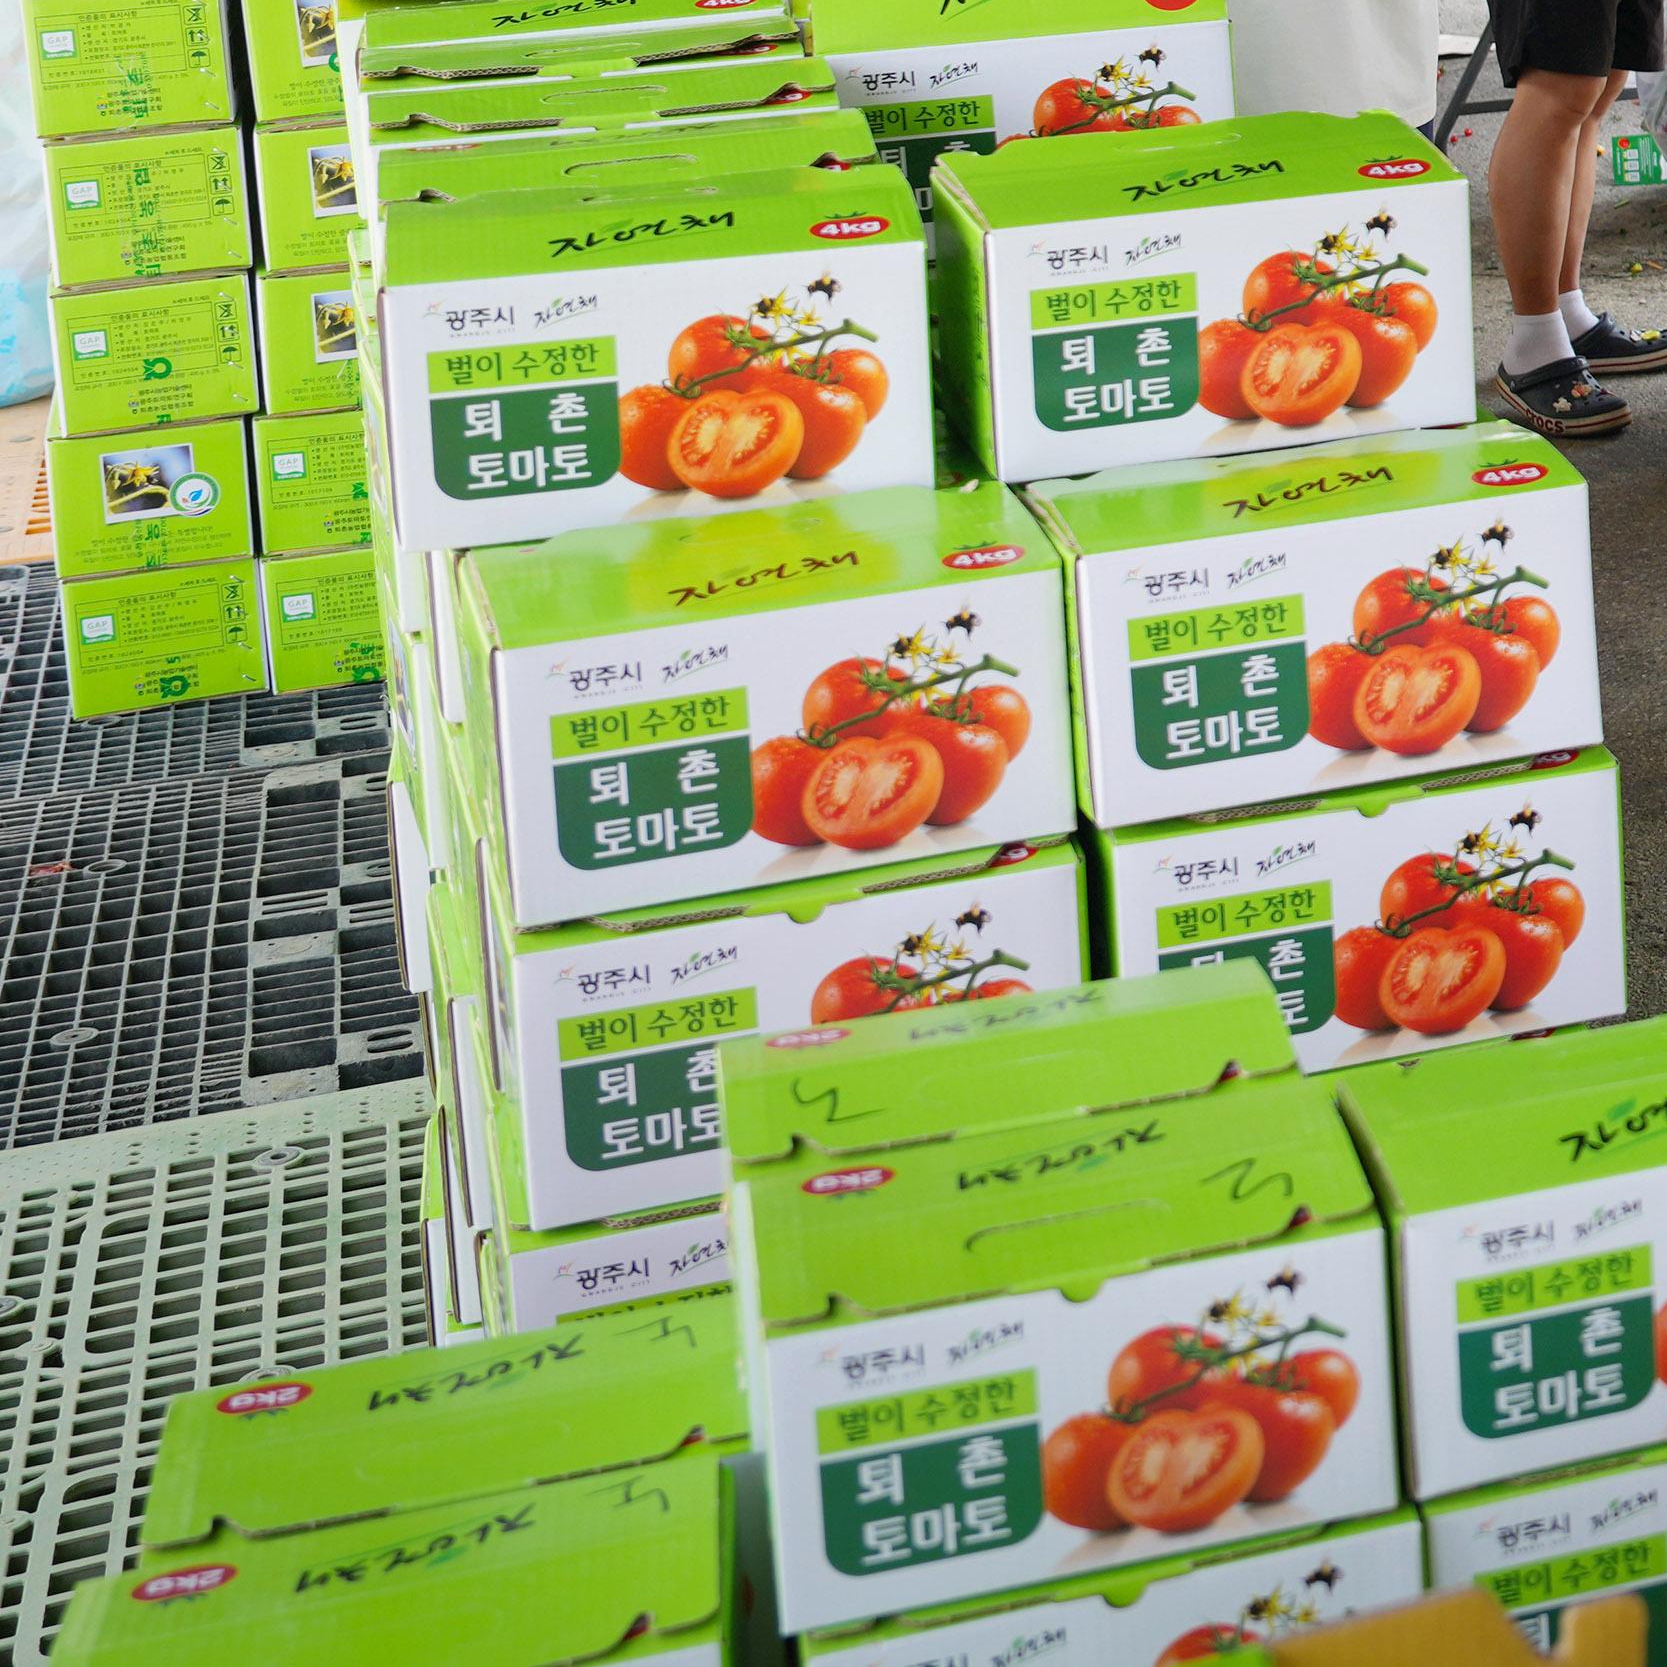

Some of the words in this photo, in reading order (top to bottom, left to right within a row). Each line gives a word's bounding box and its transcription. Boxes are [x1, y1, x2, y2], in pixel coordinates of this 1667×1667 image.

[864, 71, 916, 92] 광주시
[915, 101, 979, 129] 수정한
[1122, 158, 1285, 202] 자연채
[1366, 160, 1425, 176] 4kg
[550, 211, 735, 258] 자연채
[818, 220, 881, 237] 4kg
[1047, 246, 1108, 271] 광주시
[1125, 235, 1181, 265] 자연채
[446, 306, 515, 332] 광주시
[534, 296, 597, 327] 자연채
[1047, 290, 1095, 322] 벌이
[1106, 280, 1181, 314] 수정한
[446, 353, 501, 385] 벌이
[513, 344, 598, 378] 수정한
[1065, 377, 1174, 422] 토마토
[468, 444, 592, 490] 토마토
[1480, 466, 1541, 483] 4kg
[1222, 465, 1394, 518] 자연채
[668, 551, 860, 607] 자연채
[951, 548, 1017, 568] 4kg
[1144, 568, 1209, 597] 광주시
[1227, 554, 1286, 588] 자연채
[1145, 616, 1197, 652] 벌이
[1208, 603, 1287, 642] 수정한
[570, 662, 642, 692] 광주시
[662, 646, 728, 682] 자연채
[570, 712, 628, 749] 벌이
[641, 696, 729, 737] 수정한
[1167, 707, 1283, 759] 토마토
[594, 803, 724, 859] 토마토
[1174, 857, 1238, 886] 광주시
[1257, 842, 1315, 876] 자연채
[1174, 904, 1225, 939] 벌이
[1236, 889, 1315, 928] 수정한
[578, 964, 650, 995] 광주시
[578, 1014, 636, 1051] 벌이
[649, 997, 737, 1038] 수정한
[602, 1102, 722, 1159] 토마토
[811, 1168, 886, 1189] 2kg
[1472, 1222, 1547, 1258] 광주시
[577, 1258, 649, 1291] 광주시
[1471, 1275, 1532, 1317] 벌이
[1545, 1253, 1636, 1299] 수정한
[840, 1345, 924, 1381] 광주시
[228, 1385, 301, 1410] 2kg
[839, 1400, 906, 1444] 벌이
[921, 1377, 1023, 1425] 수정한
[1493, 1363, 1628, 1430] 토마토
[860, 1494, 1013, 1566] 토마토
[1498, 1514, 1570, 1550] 광주시
[145, 1566, 227, 1596] 2kg
[1499, 1565, 1557, 1606] 벌이
[1569, 1540, 1657, 1587] 수정한
